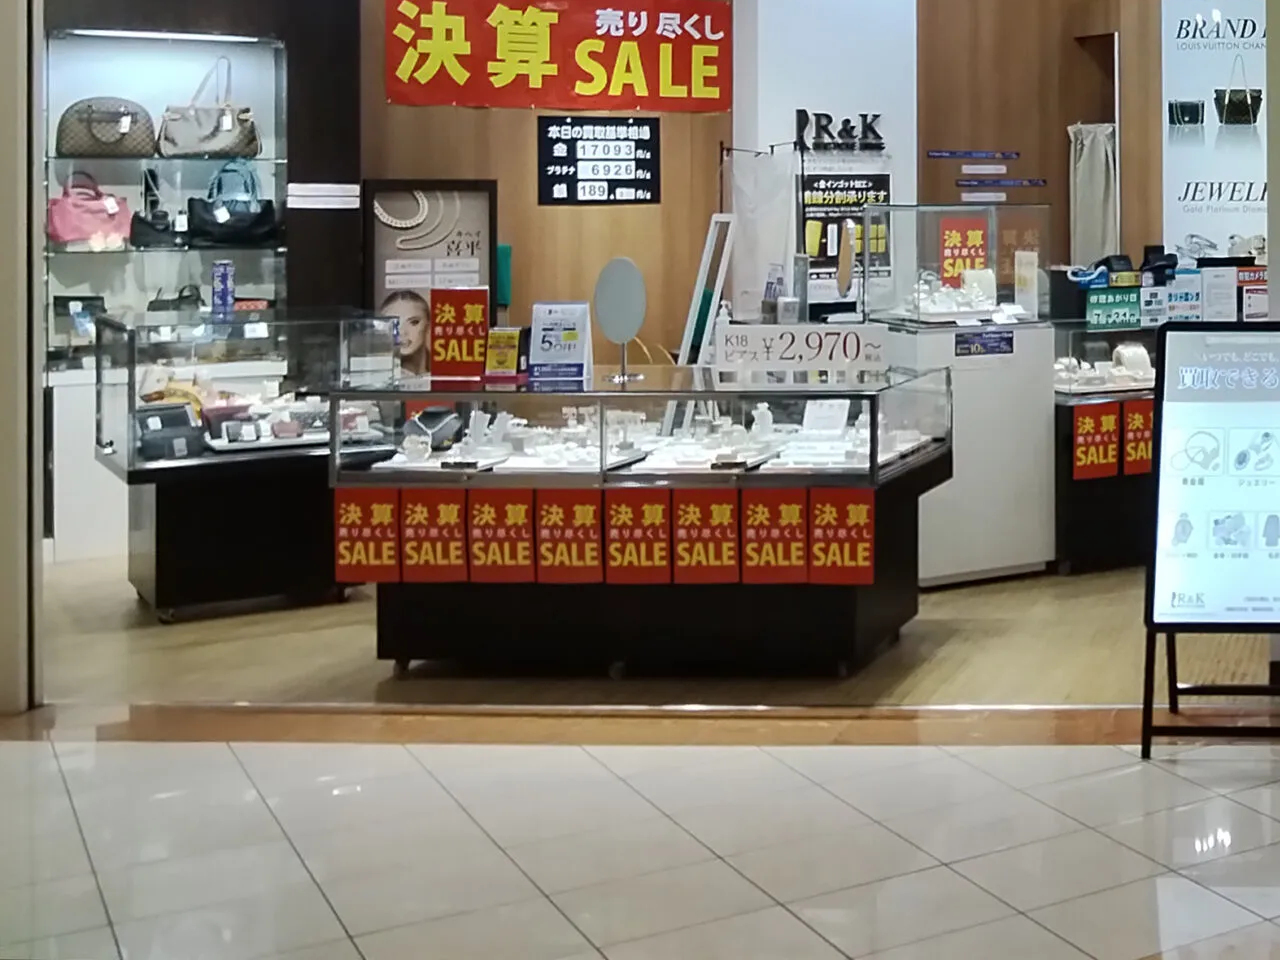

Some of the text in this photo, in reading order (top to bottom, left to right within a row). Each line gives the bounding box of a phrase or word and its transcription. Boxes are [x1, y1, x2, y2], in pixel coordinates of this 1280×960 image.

[596, 8, 725, 41] 売り尽くし
[1176, 18, 1257, 39] BRAND
[393, 0, 559, 89] 決算
[1176, 42, 1200, 51] LOUIS
[574, 39, 721, 99] SALE
[811, 112, 884, 141] R&K
[546, 165, 576, 176] プラチナ
[591, 164, 633, 176] 6926
[944, 230, 984, 247] 決算
[434, 303, 485, 324] 決算
[433, 339, 485, 362] SALE
[725, 334, 748, 348] K18
[1077, 413, 1117, 434] 決算
[1076, 443, 1117, 467] SALE
[339, 503, 395, 526] 決算
[405, 503, 460, 526] 決算
[472, 503, 528, 526] 決算
[541, 504, 596, 527] 決算
[610, 504, 665, 527] 決算
[678, 504, 734, 527] 決算
[746, 504, 802, 527] 決算
[814, 504, 871, 527] 決算
[338, 541, 396, 565] SALE
[405, 541, 463, 565] SALE
[472, 541, 531, 565] SALE
[540, 542, 599, 566] SALE
[609, 542, 667, 566] SALE
[677, 542, 736, 566] SALE
[746, 542, 804, 566] SALE
[812, 542, 871, 566] SALE
